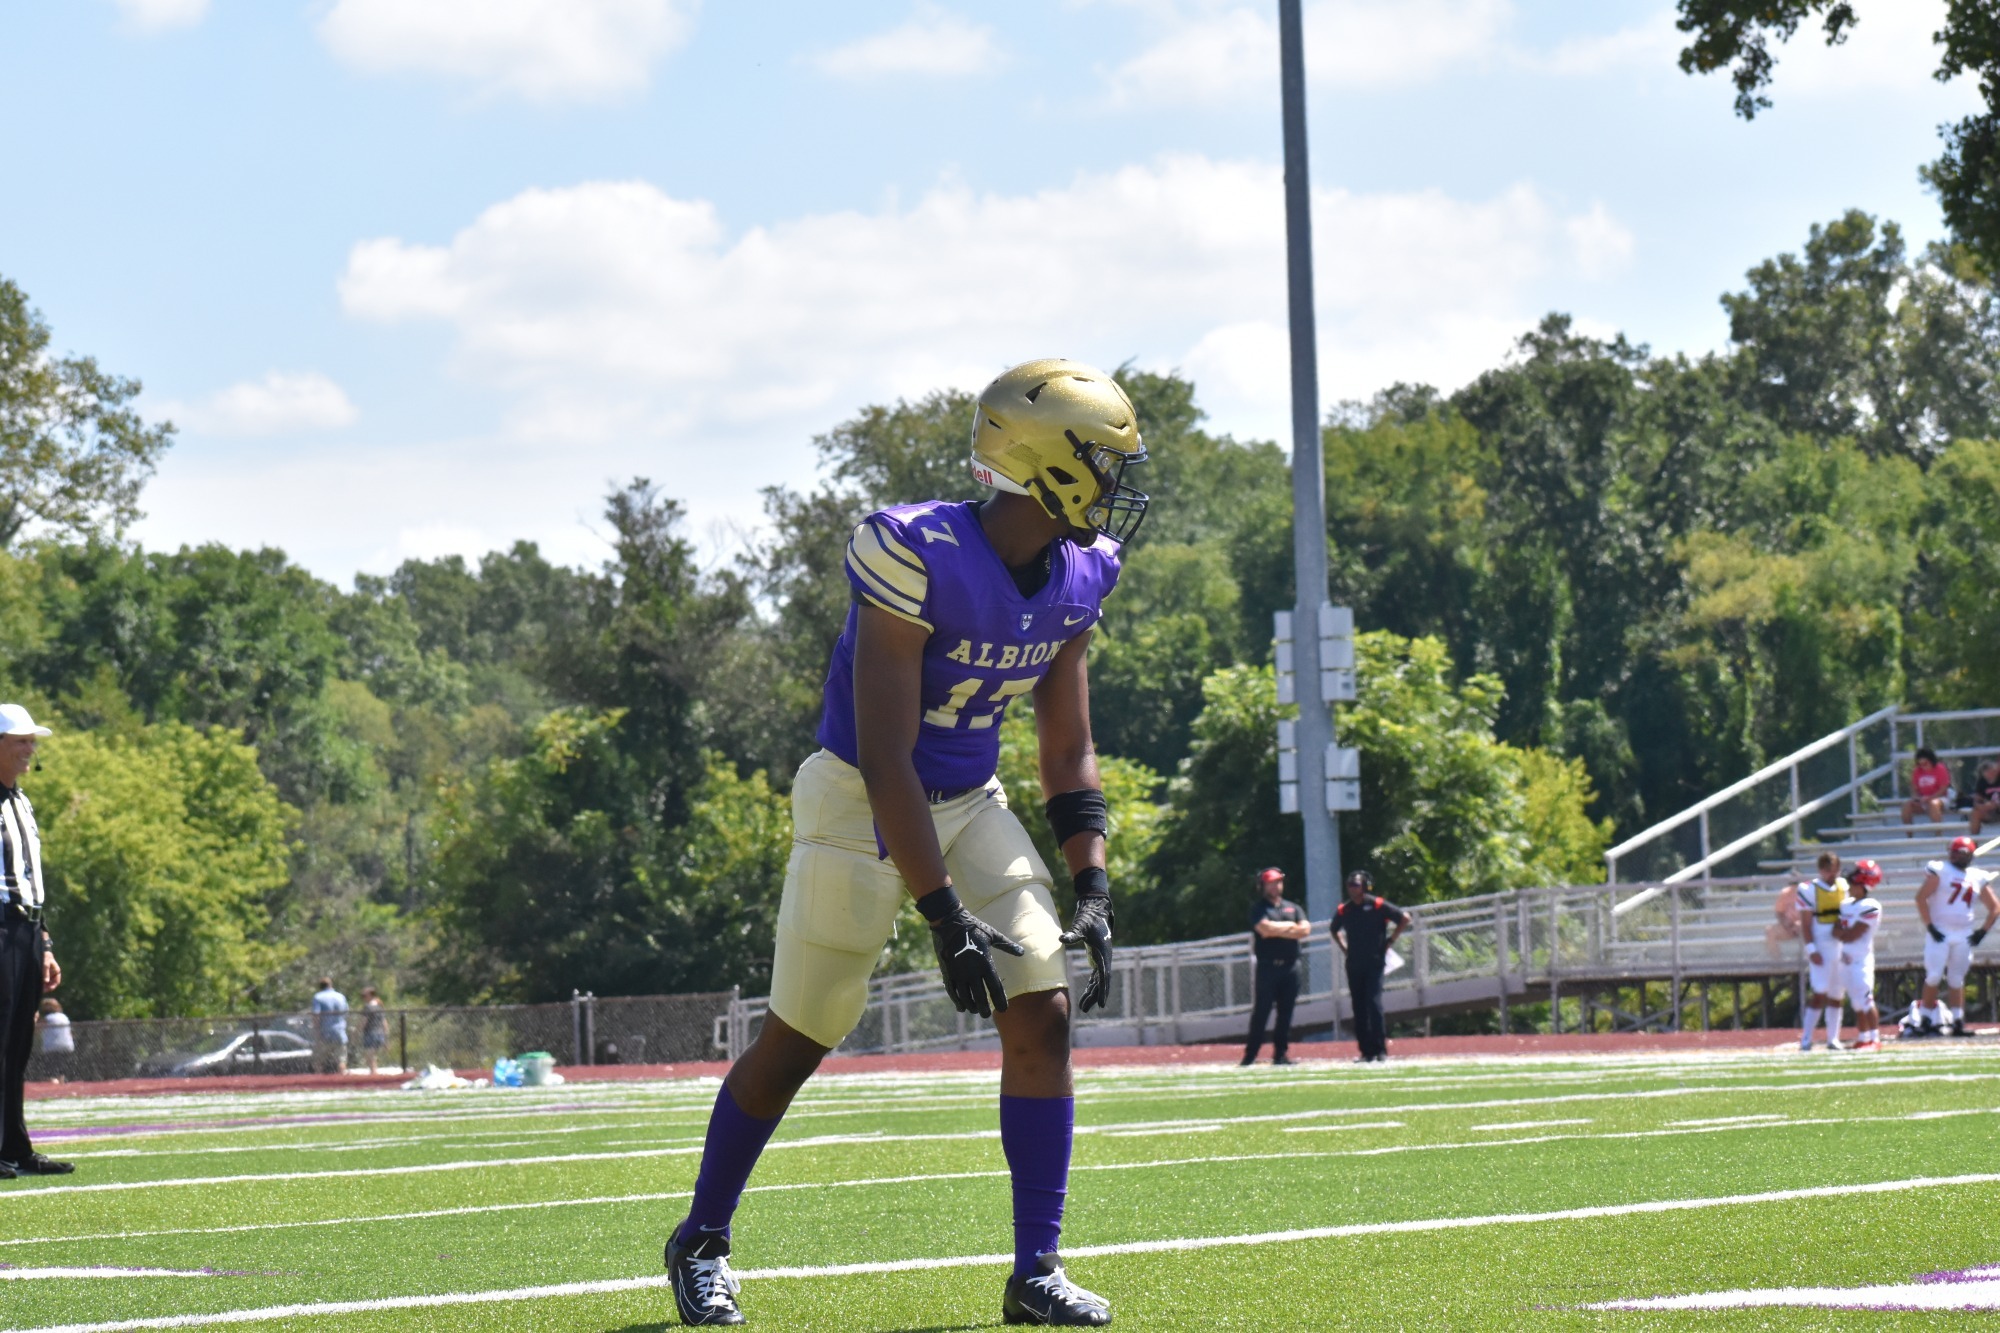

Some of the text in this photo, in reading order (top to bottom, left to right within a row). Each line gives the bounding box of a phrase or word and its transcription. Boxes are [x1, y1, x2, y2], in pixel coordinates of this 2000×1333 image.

[946, 638, 1066, 669] ALBION
[922, 675, 1041, 730] 17
[1947, 882, 1973, 909] 74
